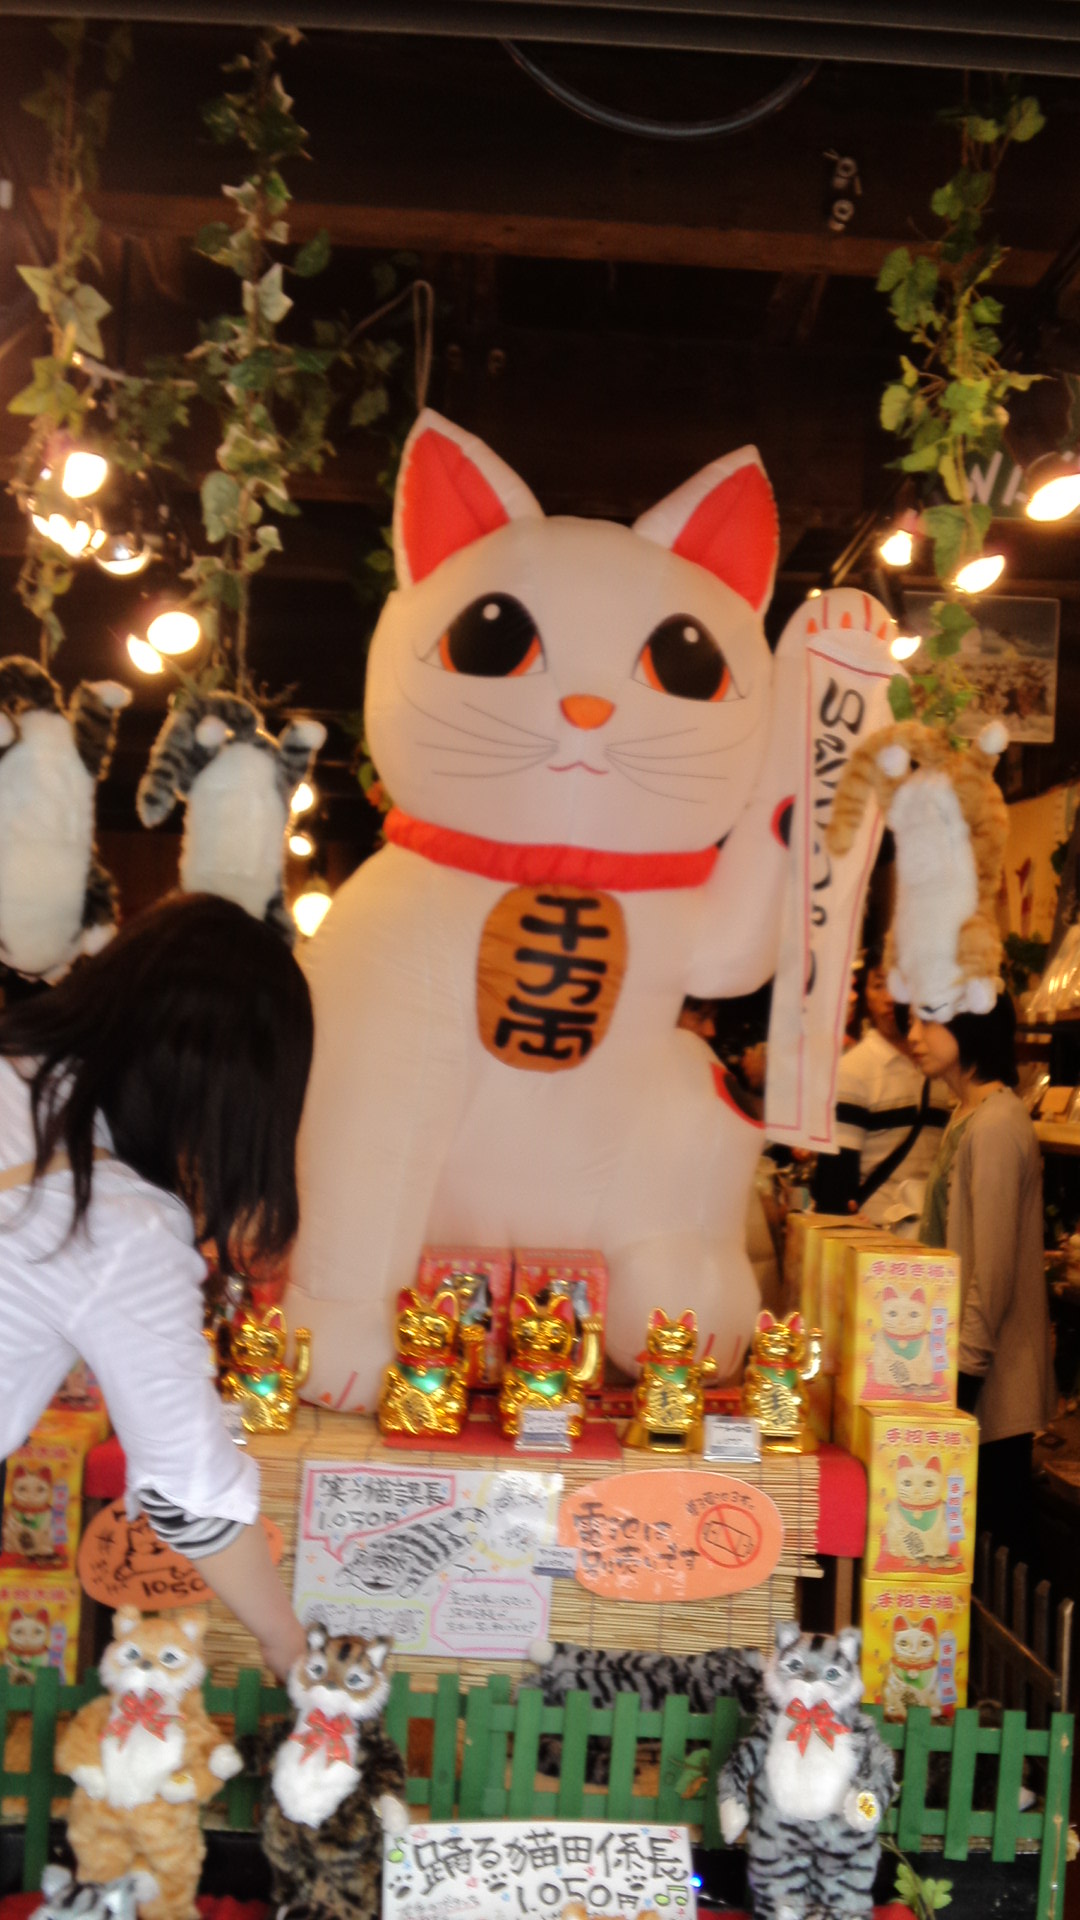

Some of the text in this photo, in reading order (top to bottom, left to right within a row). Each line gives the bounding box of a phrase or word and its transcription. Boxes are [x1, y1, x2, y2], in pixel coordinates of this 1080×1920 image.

[887, 1427, 962, 1445] 手招き猫
[413, 1828, 689, 1896] 踊る猫田係長
